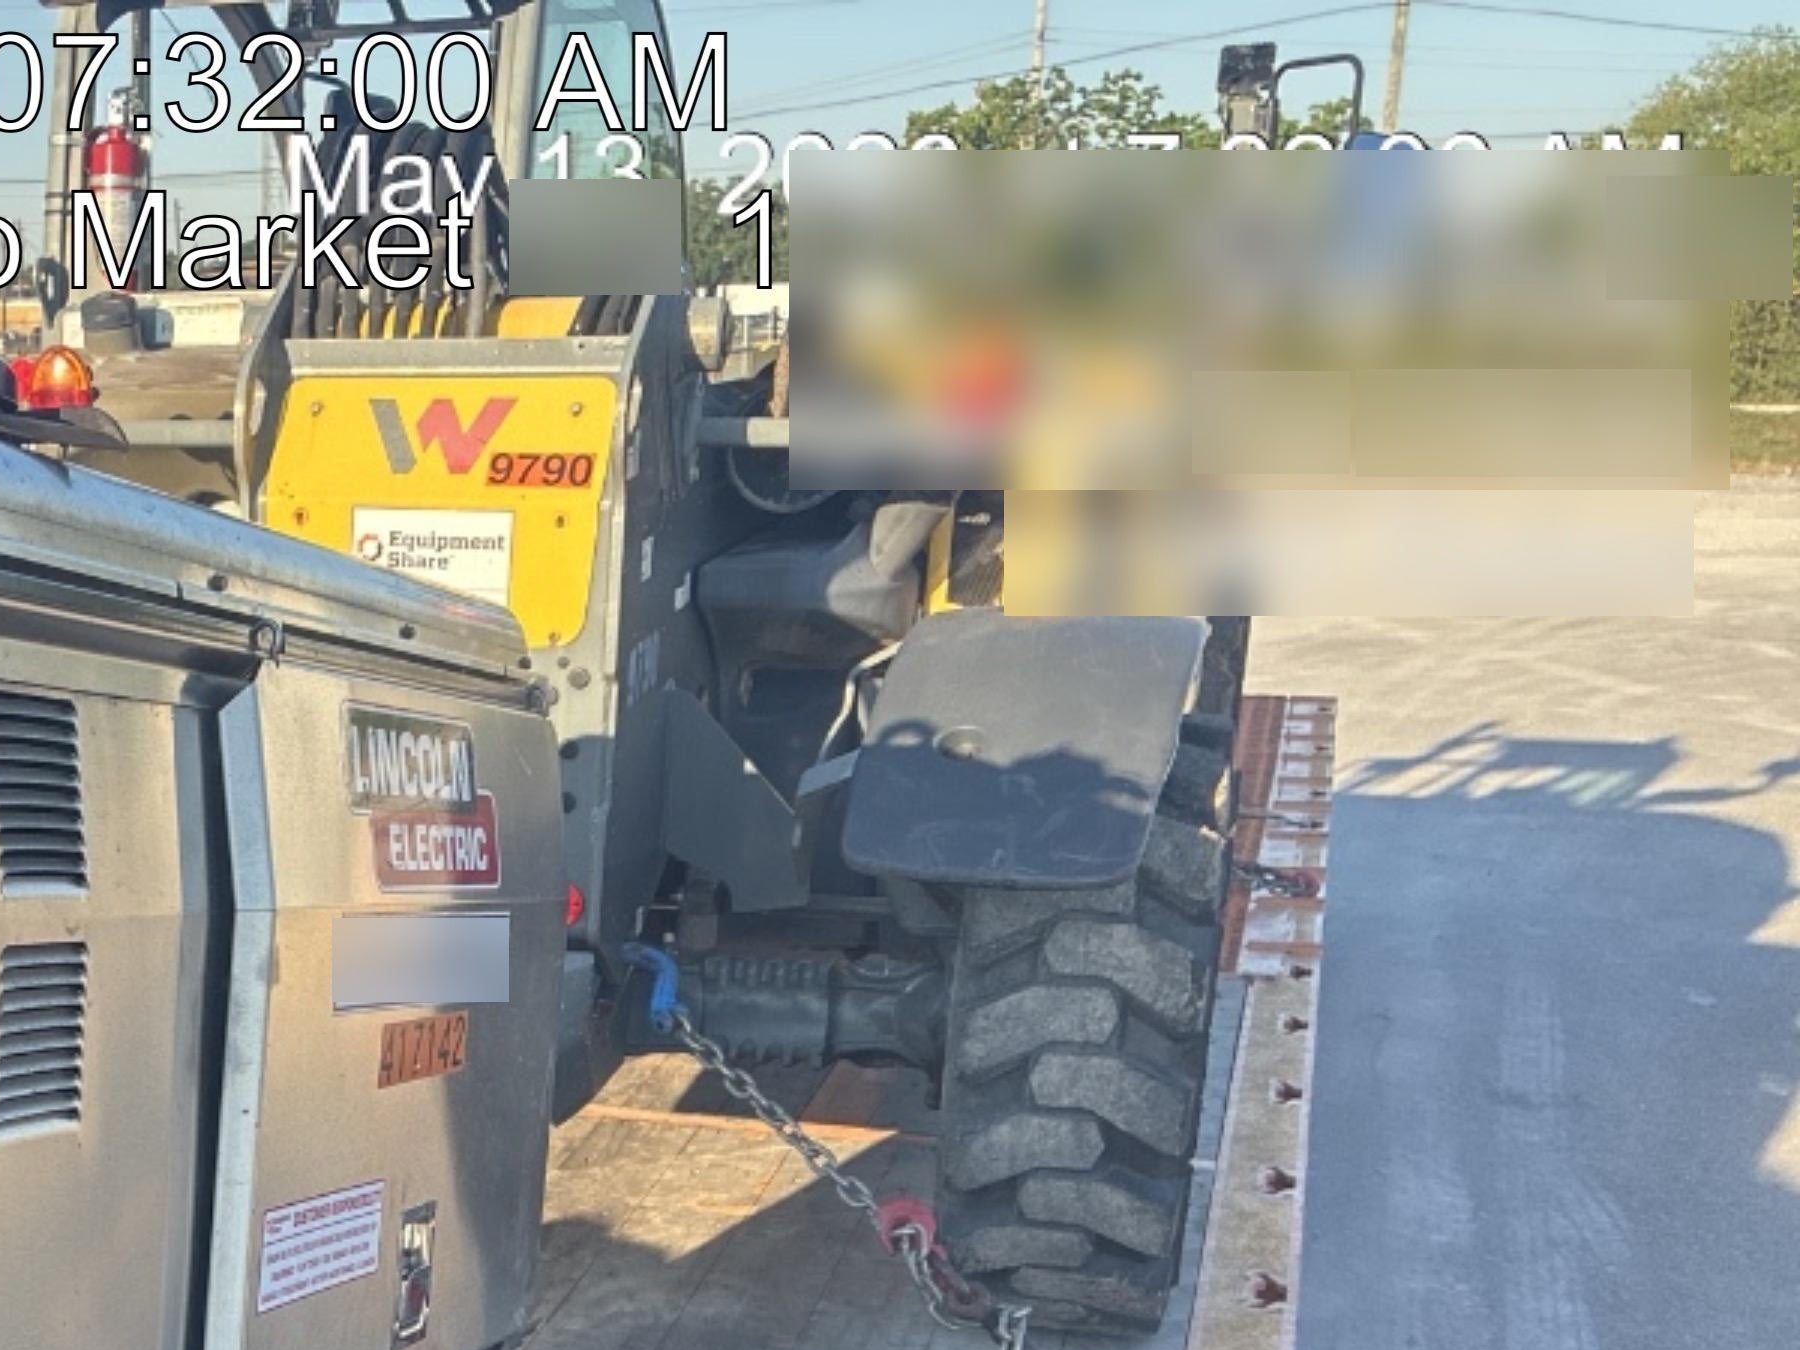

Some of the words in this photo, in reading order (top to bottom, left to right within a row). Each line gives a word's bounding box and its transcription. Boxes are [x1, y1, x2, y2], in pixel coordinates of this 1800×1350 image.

[487, 452, 594, 487] 9790
[389, 530, 506, 552] Equipment
[387, 551, 450, 570] Share
[353, 726, 472, 801] LINCOLN
[389, 822, 488, 872] ELECTRIC
